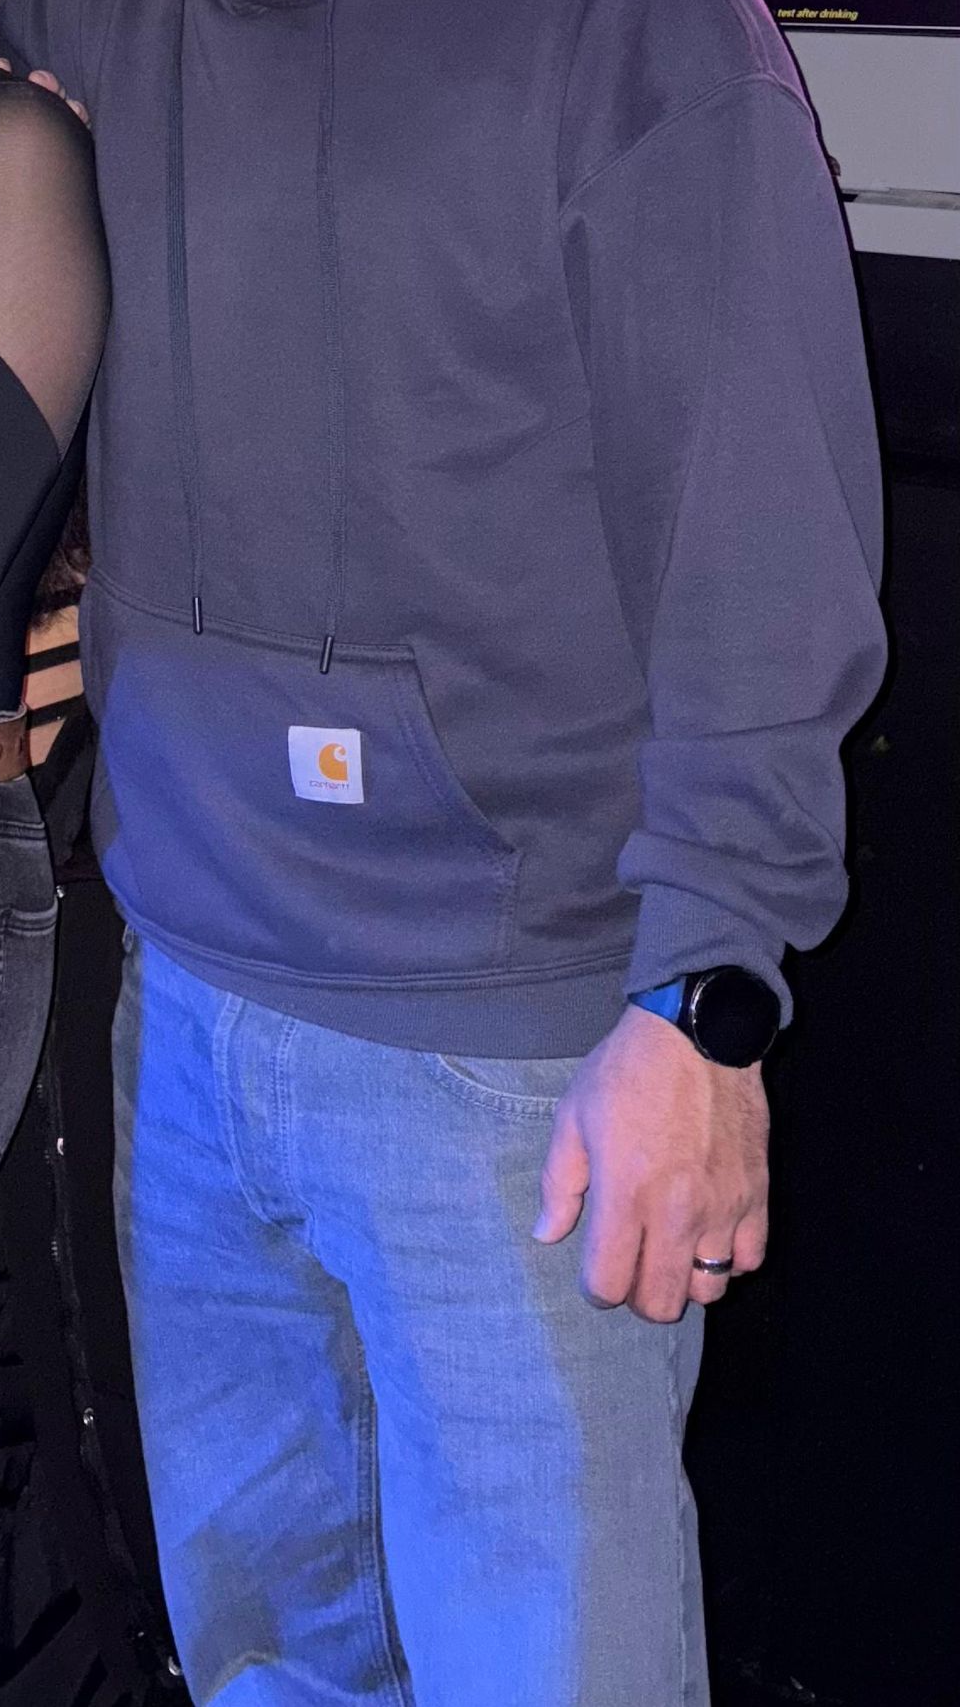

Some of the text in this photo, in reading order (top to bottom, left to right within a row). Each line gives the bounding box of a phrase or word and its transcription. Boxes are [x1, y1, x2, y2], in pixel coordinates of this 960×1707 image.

[777, 7, 859, 22] test after drinking
